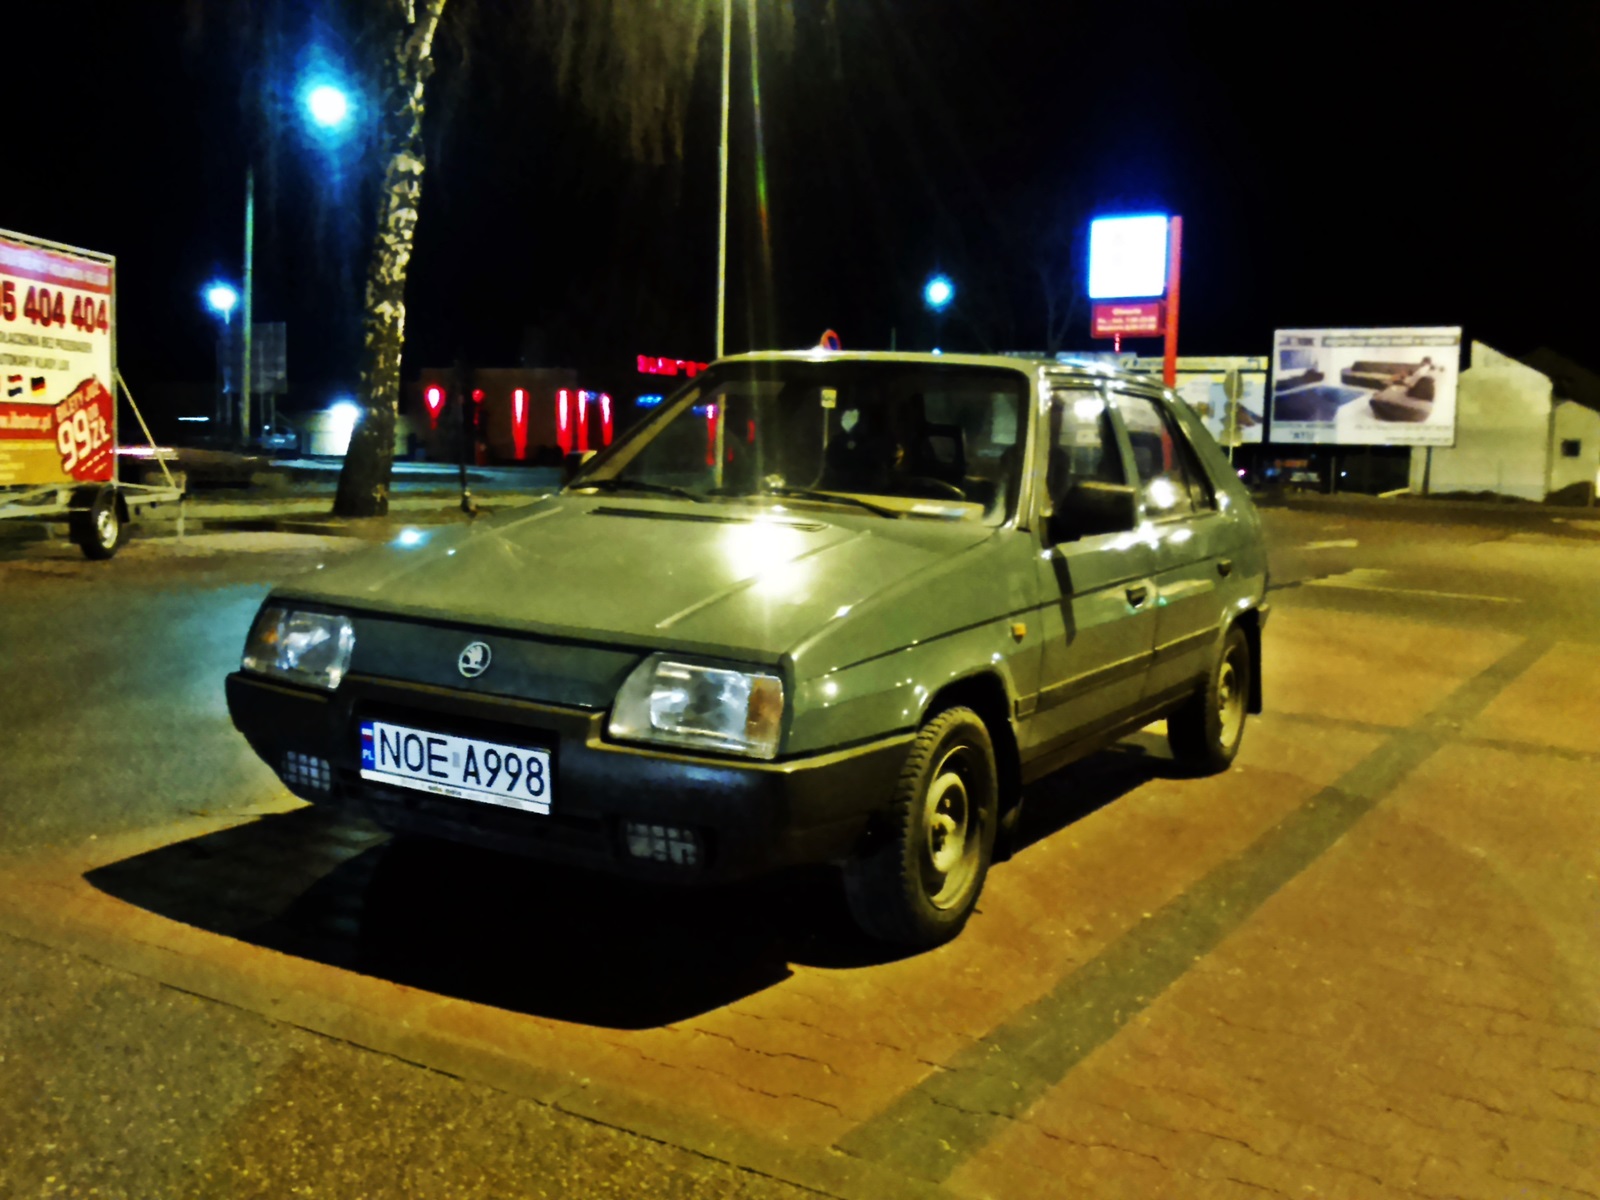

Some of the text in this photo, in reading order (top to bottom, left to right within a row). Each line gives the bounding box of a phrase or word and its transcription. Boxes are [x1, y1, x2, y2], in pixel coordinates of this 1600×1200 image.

[0, 280, 109, 335] 5 404 404
[57, 409, 92, 472] 99
[362, 749, 375, 761] PL
[380, 728, 449, 779] NOE
[463, 744, 545, 797] A998
